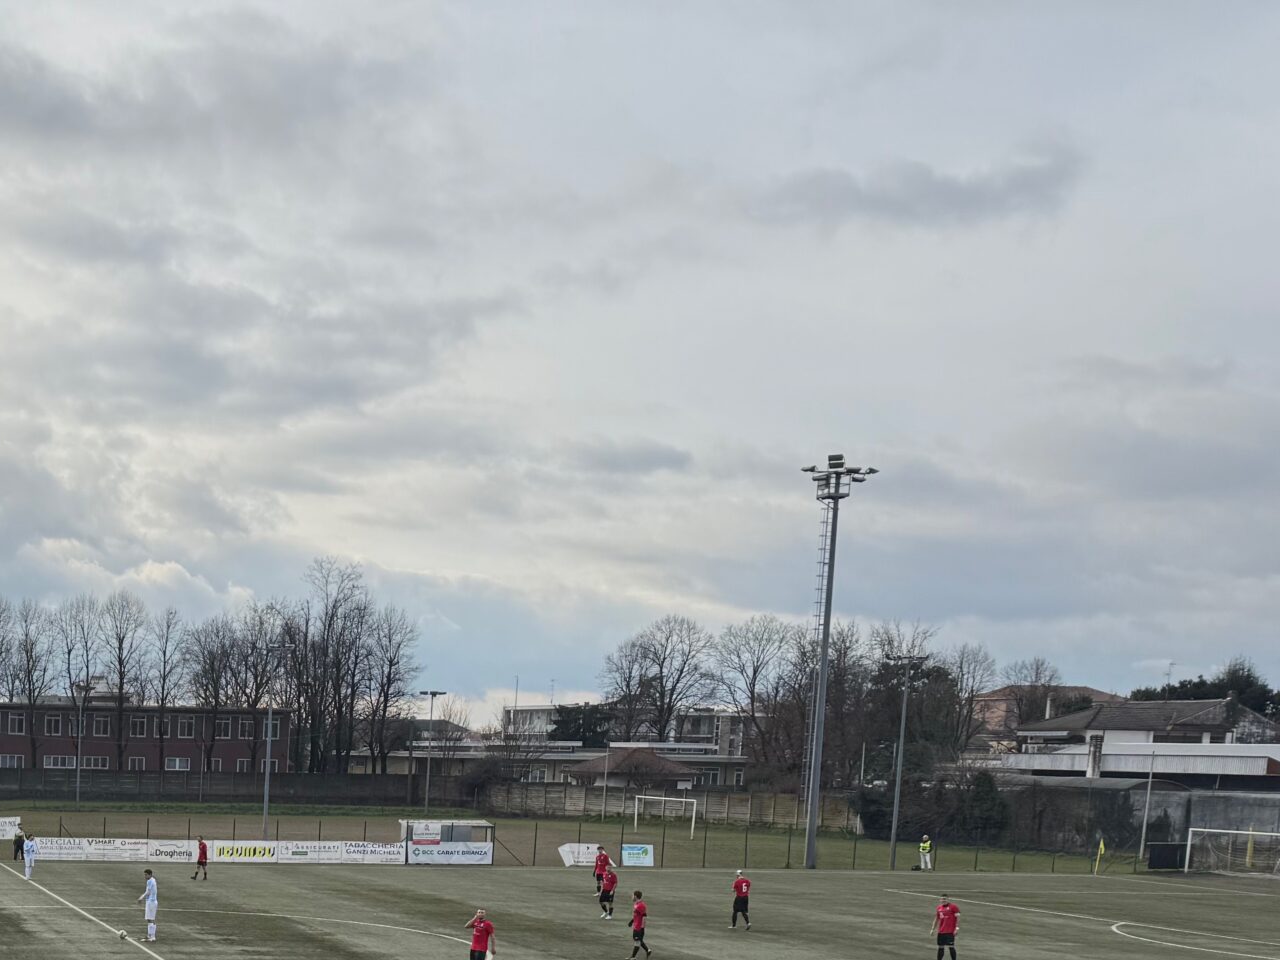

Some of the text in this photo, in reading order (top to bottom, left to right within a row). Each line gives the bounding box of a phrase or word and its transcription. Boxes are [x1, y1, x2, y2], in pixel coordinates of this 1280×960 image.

[39, 838, 83, 846] SPECIALE
[155, 849, 193, 858] Drogheria
[742, 882, 748, 893] 6
